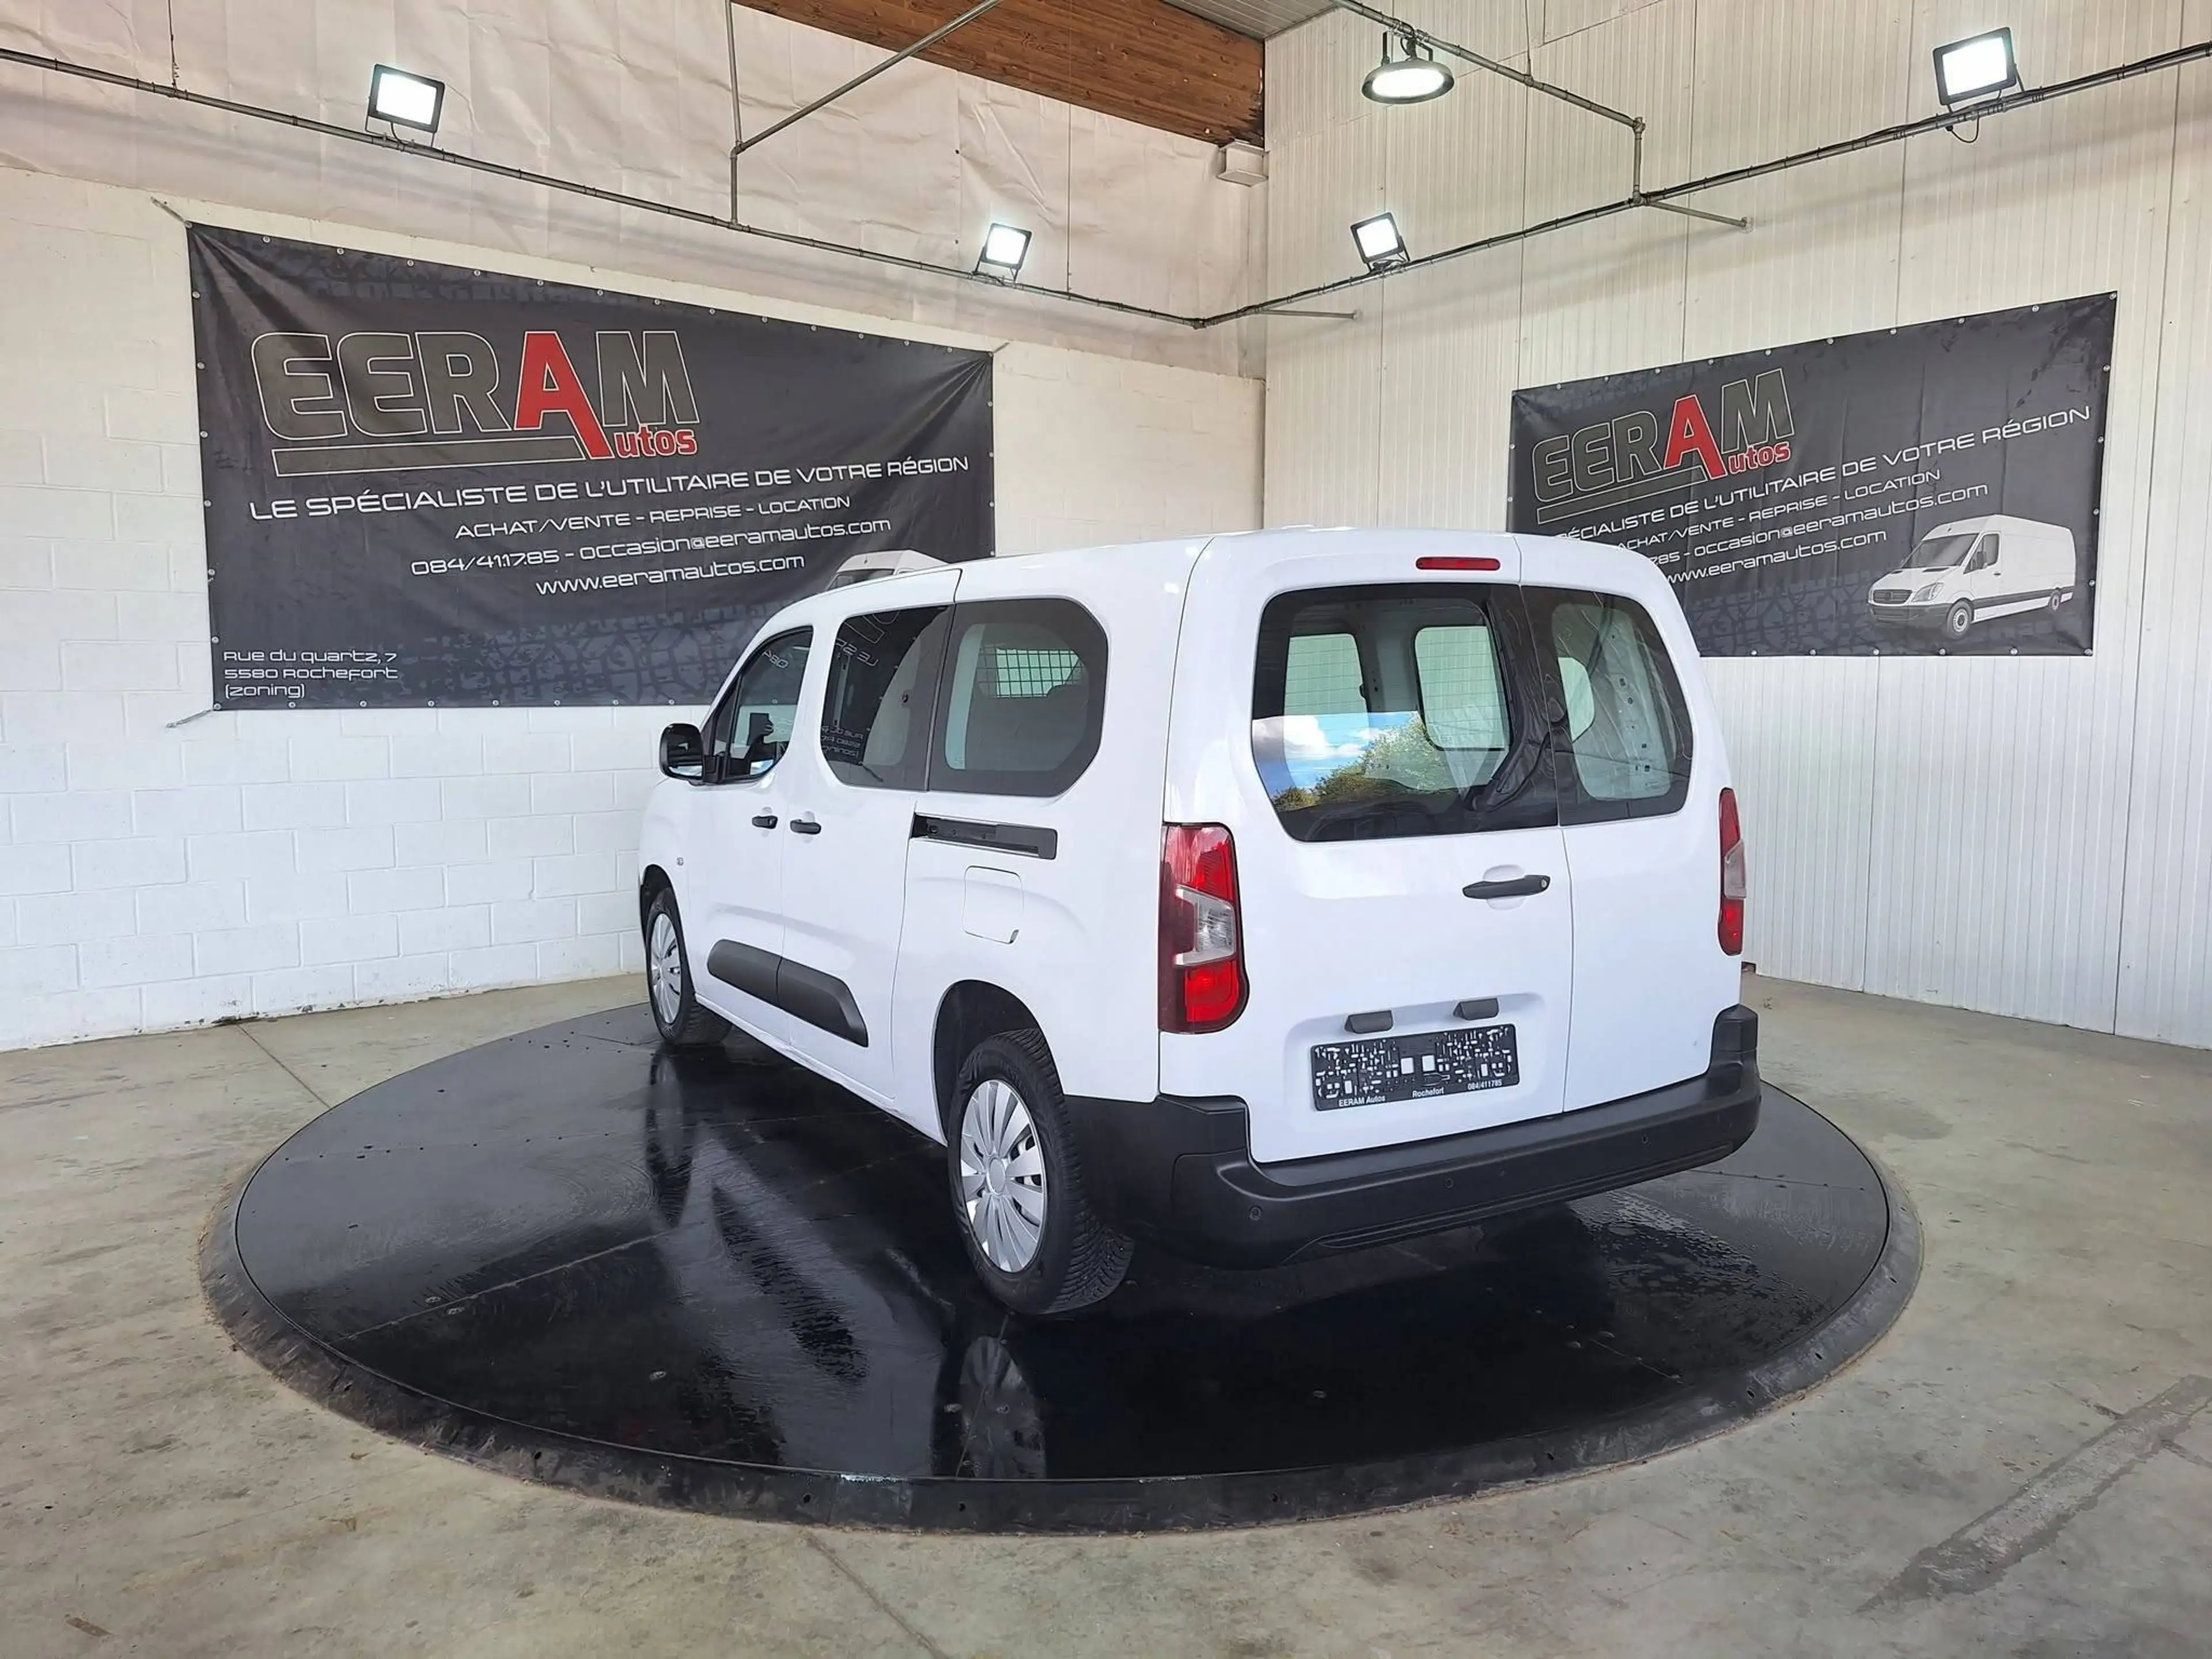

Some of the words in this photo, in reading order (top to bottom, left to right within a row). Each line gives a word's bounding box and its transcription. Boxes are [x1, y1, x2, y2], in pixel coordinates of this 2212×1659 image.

[251, 331, 700, 459] EERAM
[1532, 368, 1795, 502] EERAM
[249, 499, 298, 520] LE
[306, 484, 528, 517] SPÉCIALISTE
[535, 482, 578, 501] DE
[585, 472, 749, 499] L'UTILITAIRE
[756, 468, 791, 486] DE
[796, 463, 882, 484] VOTRE
[1671, 501, 1699, 517] DE
[1704, 467, 1836, 510] L'UTILITAIRE
[1843, 456, 1877, 477] DE
[1882, 433, 1975, 465] VOTRE
[1749, 495, 1828, 523] REPRISE
[1844, 468, 1941, 500] LOCATION
[455, 513, 631, 539] ACHAT/VENTE
[650, 503, 741, 524] REPRISE
[758, 496, 850, 515] LOCATION
[579, 518, 891, 560] occasion@eeramautos.com
[1695, 484, 1988, 557] occasion@eeramautos.com
[536, 553, 805, 595] www.eeramautos.com
[224, 668, 278, 679] 5580
[270, 649, 297, 662] du
[225, 684, 305, 699] (zoning)
[1339, 1096, 1365, 1107] EERAM
